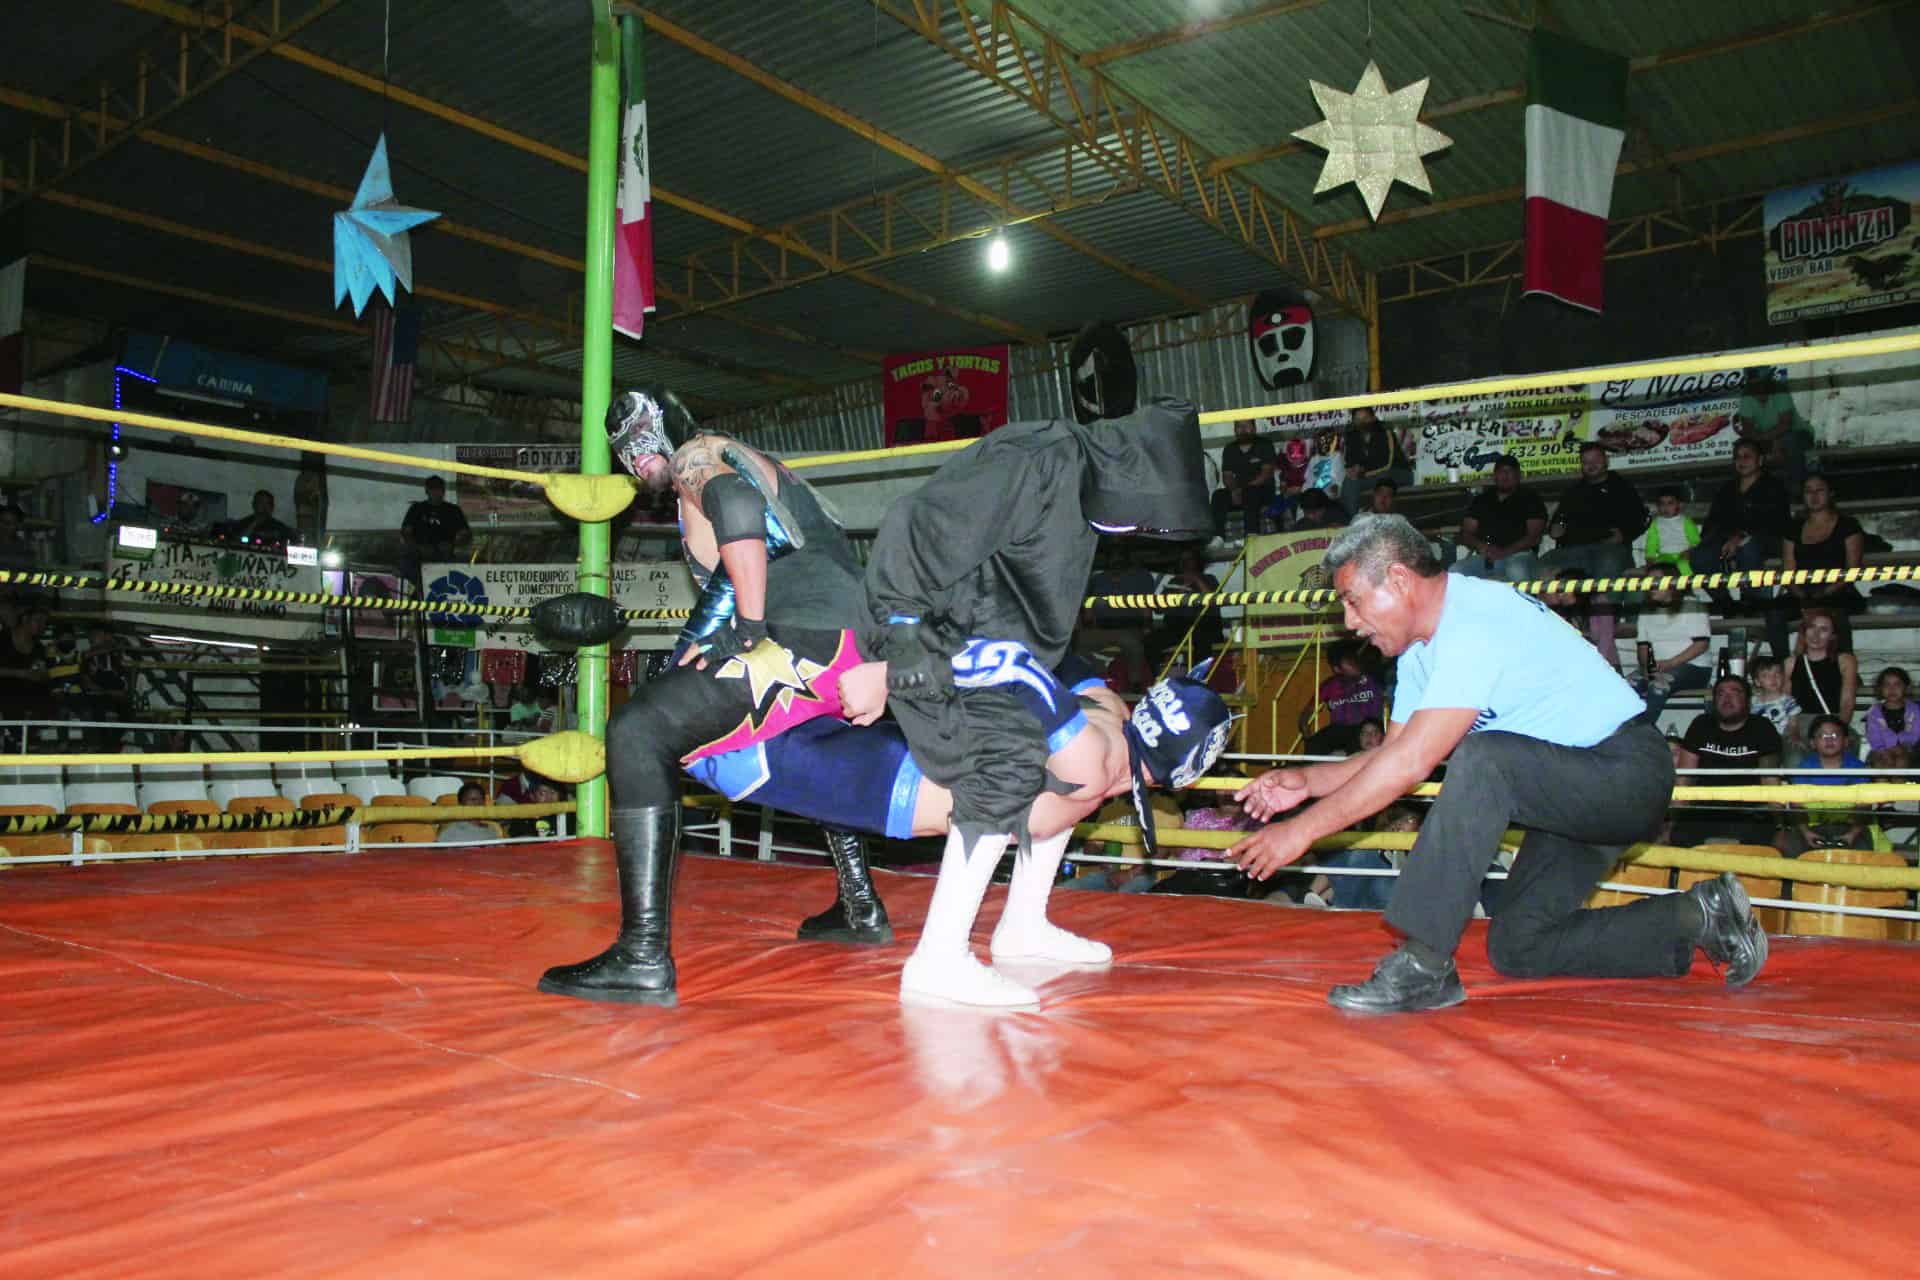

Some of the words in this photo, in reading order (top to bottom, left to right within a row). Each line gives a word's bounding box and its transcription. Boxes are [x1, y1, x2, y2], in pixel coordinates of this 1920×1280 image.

[1780, 206, 1896, 262] BONANZA
[1809, 259, 1833, 274] BAR
[891, 358, 934, 382] TACOS
[936, 357, 945, 369] Y
[949, 355, 1000, 374] TORTAS
[196, 374, 254, 395] CABINA
[1702, 402, 1739, 413] MARIS
[1540, 443, 1561, 456] 90
[649, 570, 670, 582] FAX
[505, 583, 512, 595] Y
